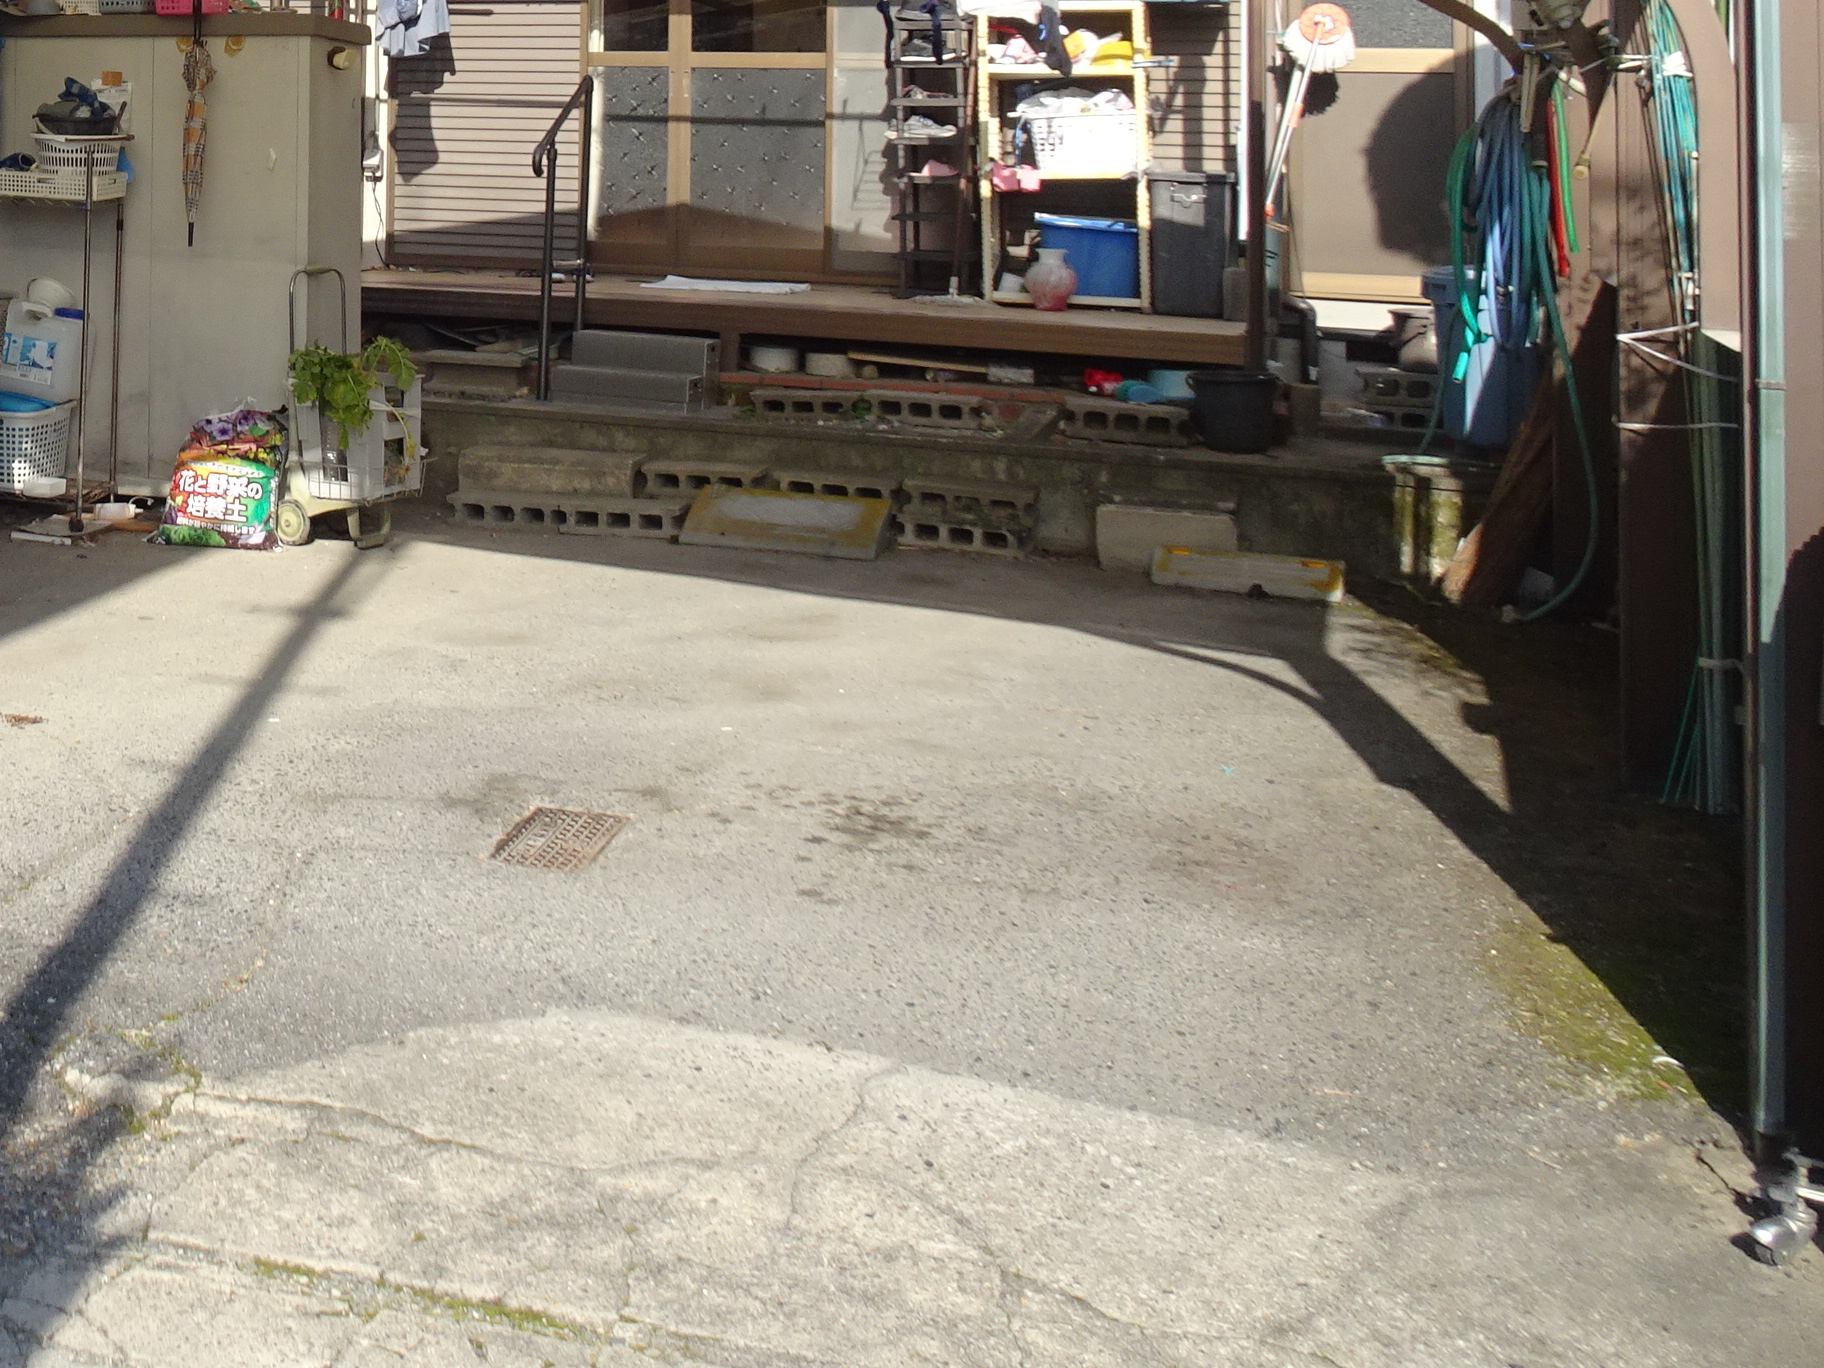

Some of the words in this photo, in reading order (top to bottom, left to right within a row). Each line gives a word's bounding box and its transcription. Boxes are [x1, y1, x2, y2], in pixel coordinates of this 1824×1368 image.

[179, 469, 263, 500] 花と野菜の
[186, 493, 248, 523] 培養土
